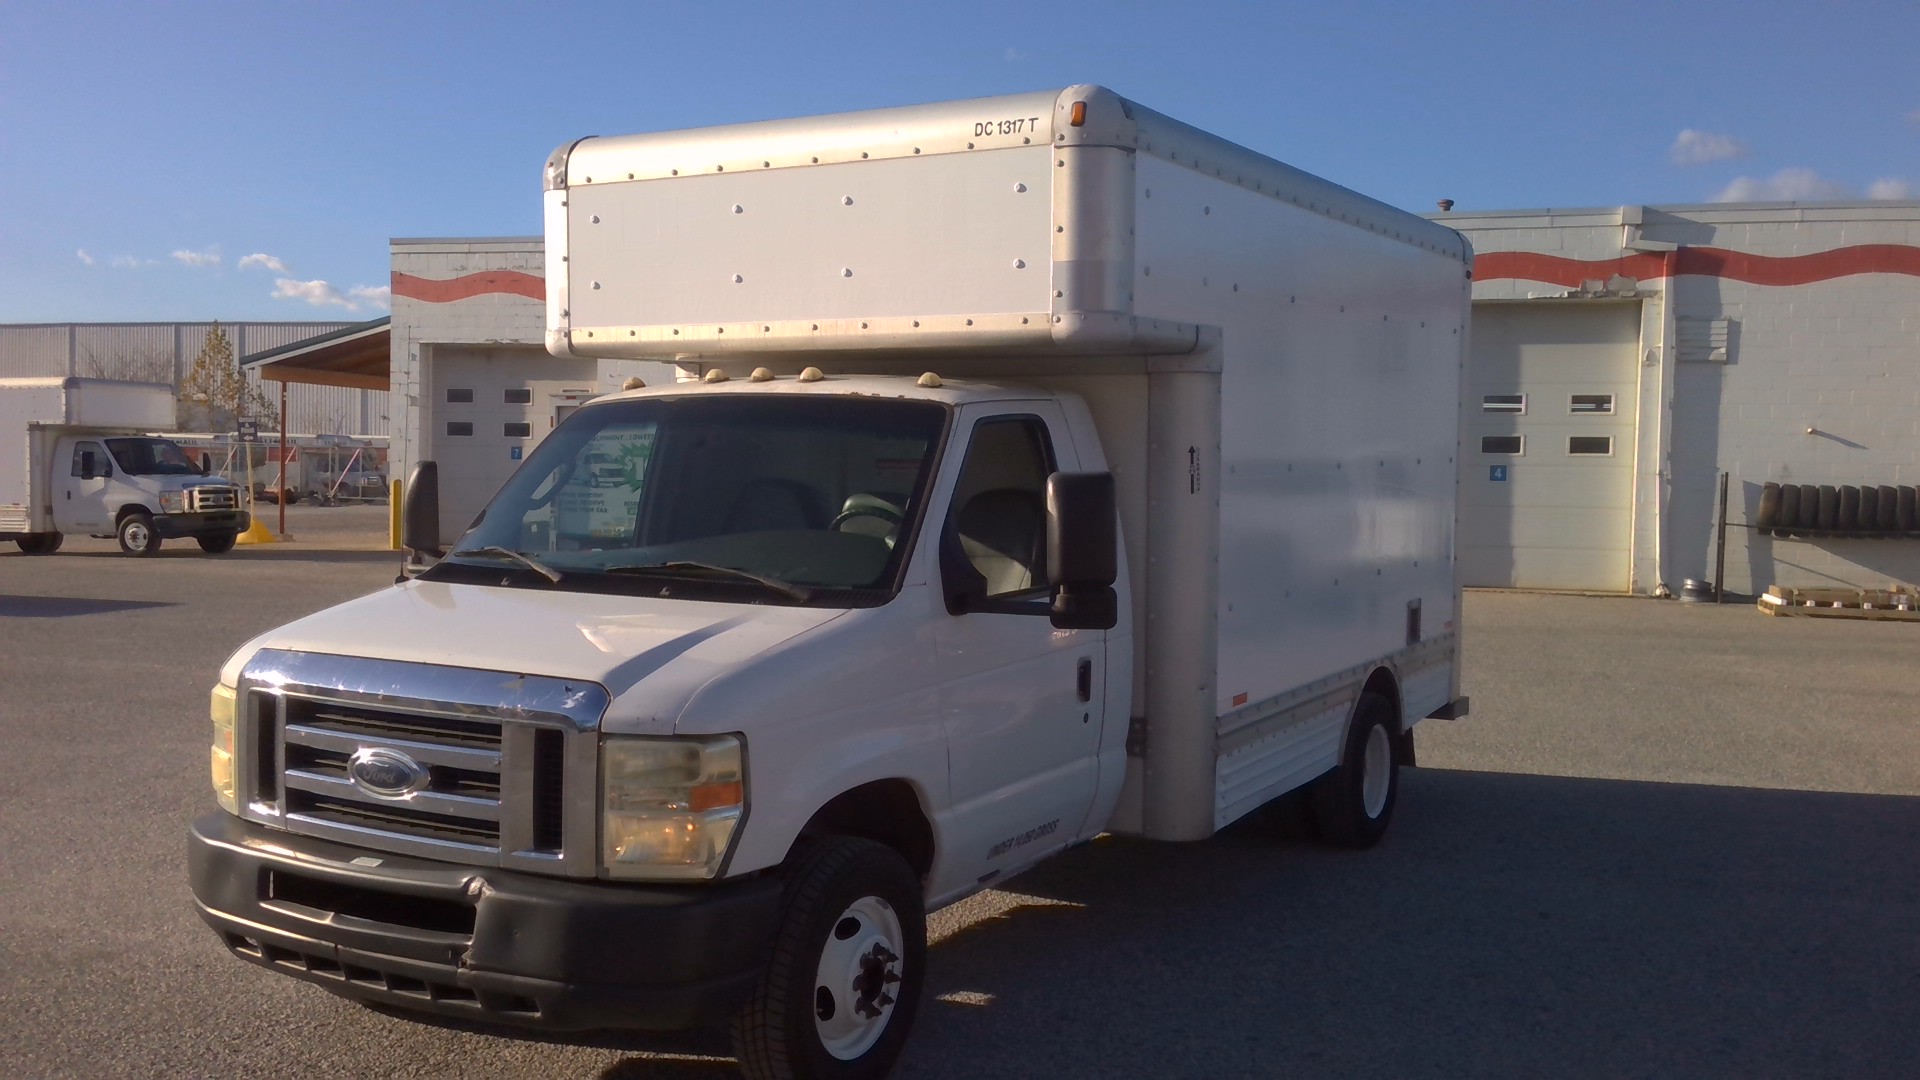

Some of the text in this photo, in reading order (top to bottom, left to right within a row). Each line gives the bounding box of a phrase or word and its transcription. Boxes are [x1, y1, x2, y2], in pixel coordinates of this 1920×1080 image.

[975, 117, 1039, 137] DC 1317 T
[624, 455, 648, 481] $1
[1494, 467, 1502, 479] 4
[362, 763, 396, 784] Ford
